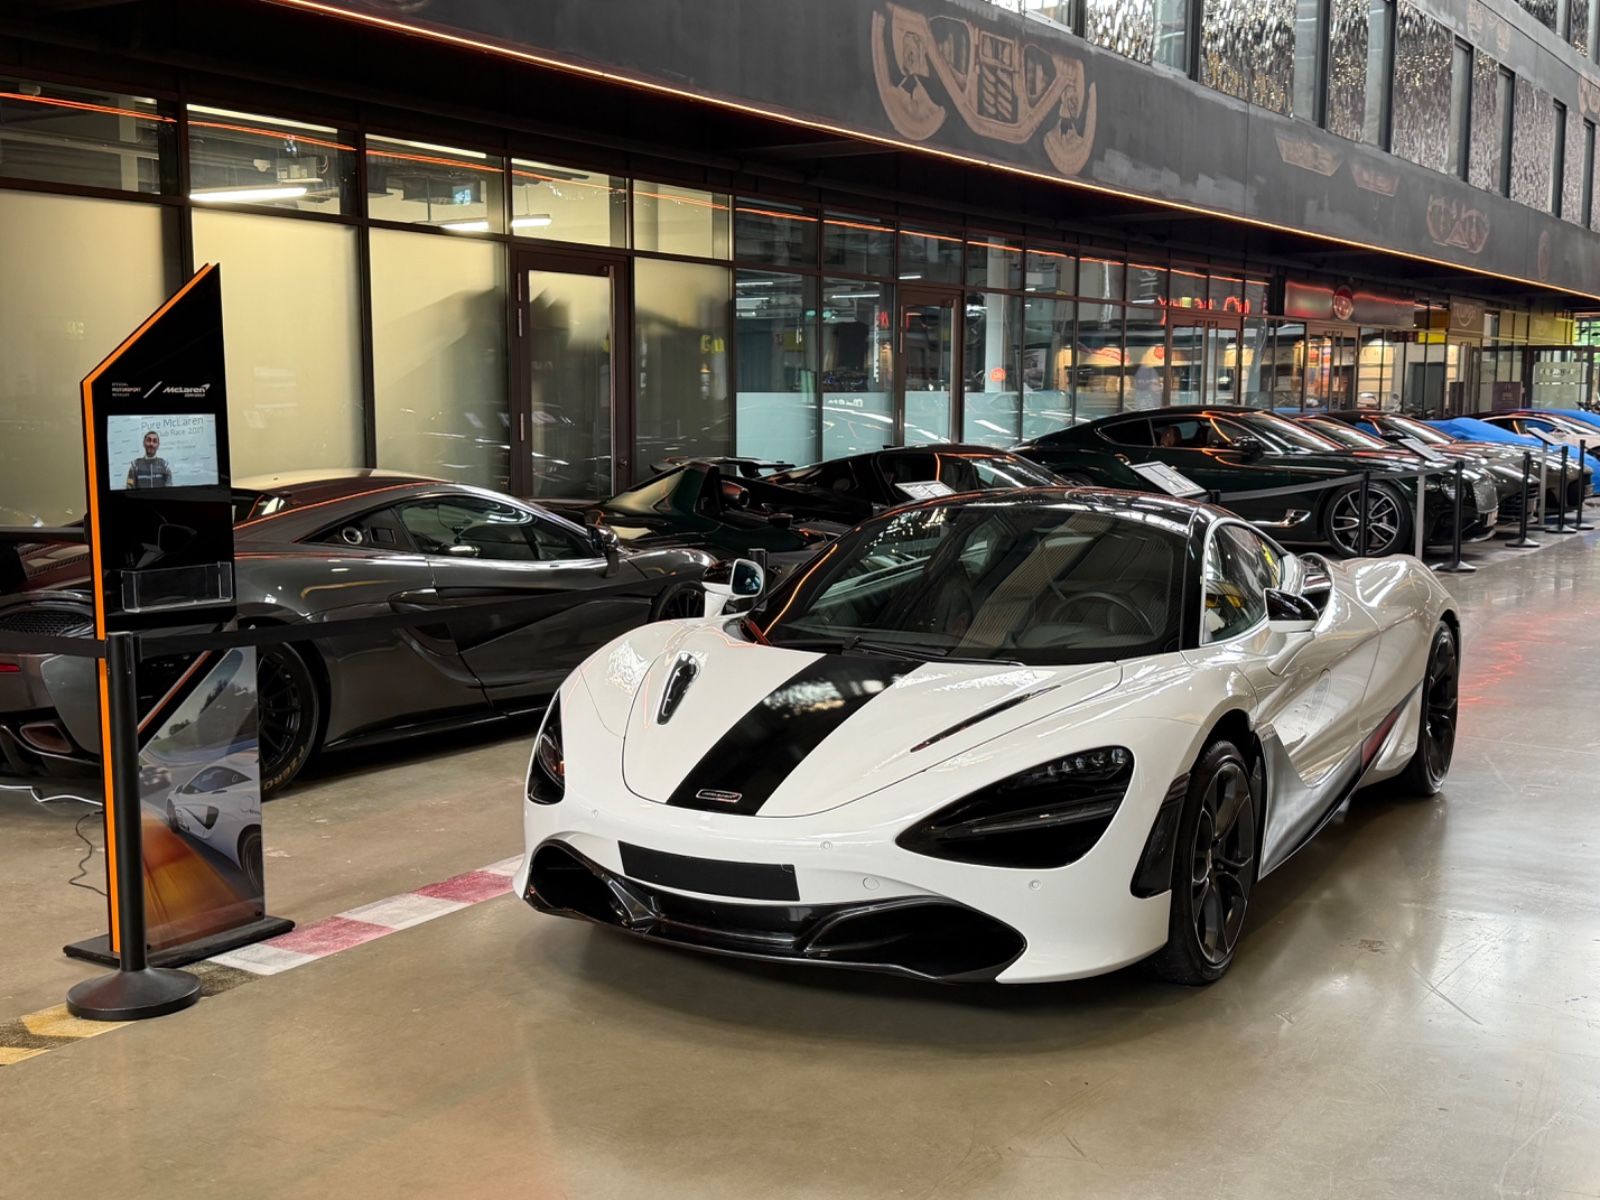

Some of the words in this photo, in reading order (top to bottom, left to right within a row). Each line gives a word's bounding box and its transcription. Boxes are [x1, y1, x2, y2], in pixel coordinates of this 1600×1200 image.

[163, 386, 207, 394] McLaren
[141, 421, 161, 430] Pure
[163, 417, 204, 427] McLaren
